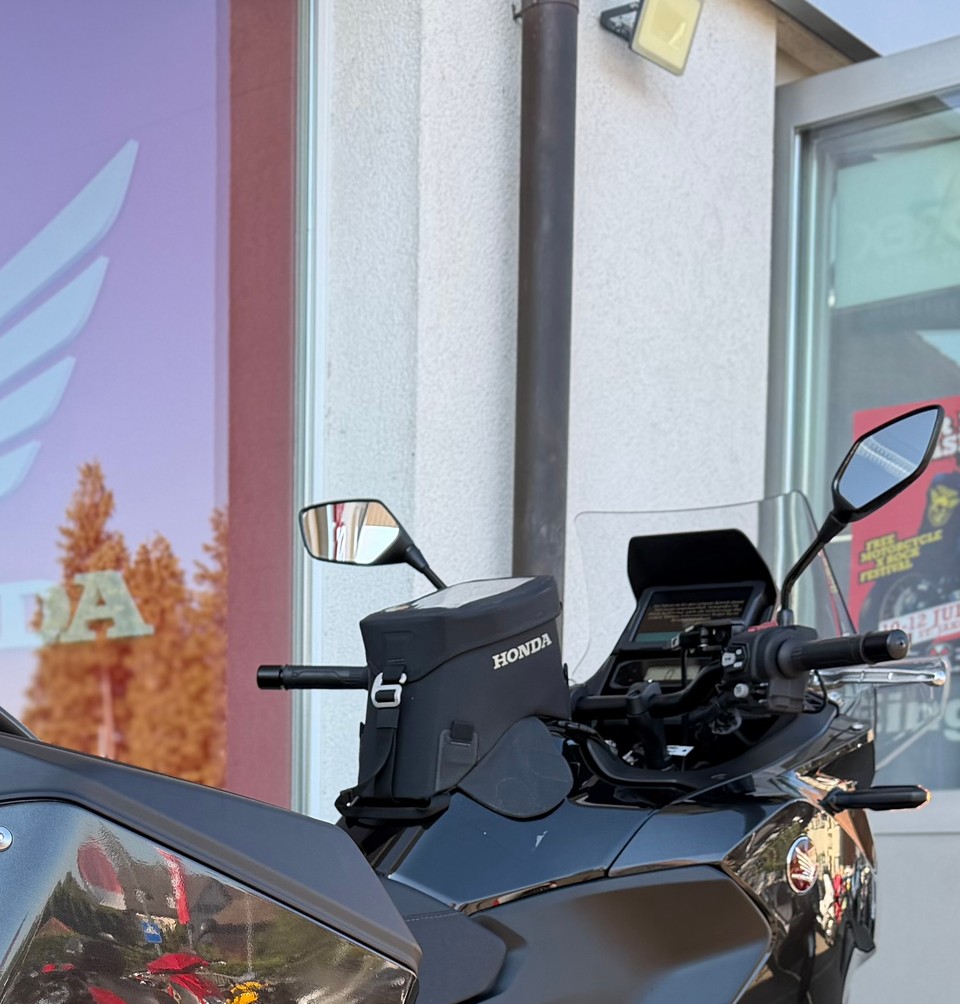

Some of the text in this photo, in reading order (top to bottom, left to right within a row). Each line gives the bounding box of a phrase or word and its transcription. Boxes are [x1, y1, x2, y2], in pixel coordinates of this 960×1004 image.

[860, 529, 943, 563] MOTORCYCLE
[886, 546, 920, 564] ROCK
[860, 559, 914, 583] FESTIVAL
[491, 632, 553, 670] HONDA
